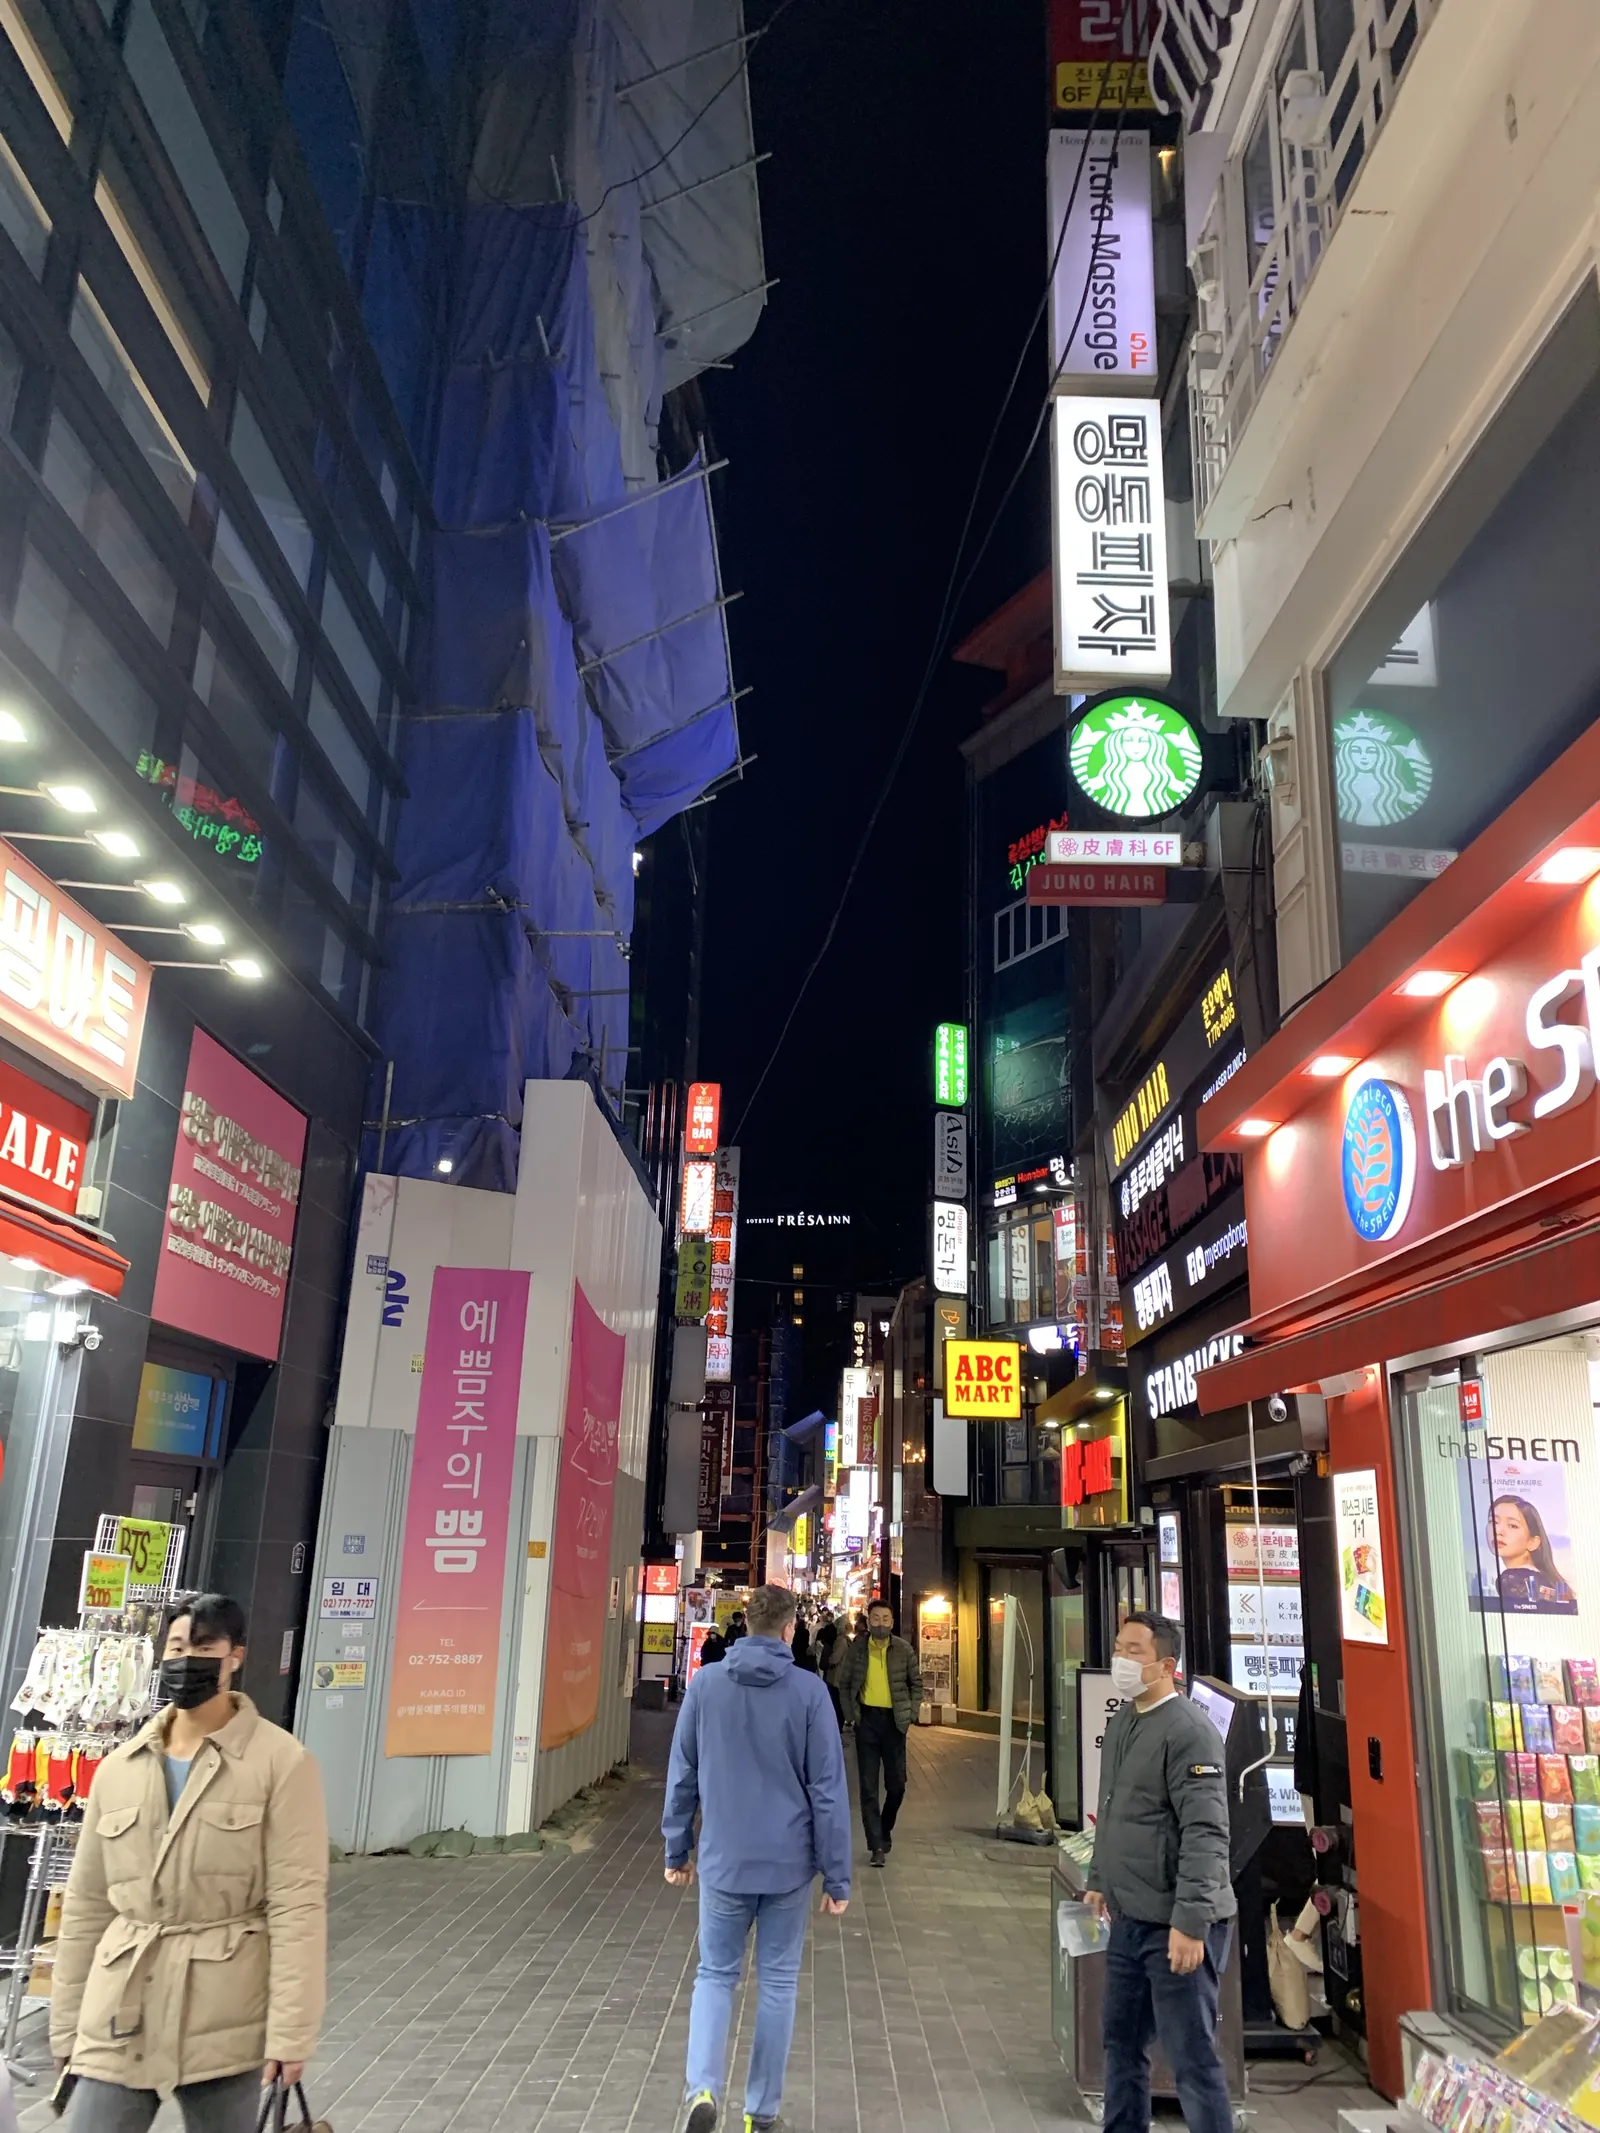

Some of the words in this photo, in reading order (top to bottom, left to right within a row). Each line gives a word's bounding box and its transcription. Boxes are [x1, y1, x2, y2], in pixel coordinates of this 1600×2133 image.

[1062, 85, 1092, 103] 6F
[1085, 232, 1121, 371] Massage
[1073, 414, 1157, 657] 명동피자
[1081, 838, 1148, 857] 皮膚科
[1153, 839, 1175, 856] 6F
[1041, 875, 1096, 891] JUNO
[1103, 875, 1156, 891] HAIR
[1202, 968, 1233, 1030] 준오헤어
[693, 1111, 714, 1124] PUB
[1112, 1102, 1140, 1167] JUNO
[1138, 1061, 1170, 1133] HAIR
[1424, 1054, 1525, 1171] the
[691, 1127, 713, 1139] BAR
[0, 1104, 78, 1191] ALE
[777, 1210, 825, 1226] FRÉSA
[828, 1215, 851, 1225] INN
[1369, 1190, 1396, 1234] SAEM
[937, 1209, 957, 1276] 명돈가
[1132, 1261, 1174, 1331] 명동피자
[955, 1354, 1012, 1382] ABC
[955, 1385, 1014, 1403] MART
[1438, 1434, 1478, 1460] the
[1487, 1436, 1580, 1463] SAEM
[1342, 1498, 1361, 1517] 마스크
[1361, 1497, 1375, 1516] 시트
[1352, 1518, 1365, 1539] 1+1
[120, 1526, 151, 1574] BTS
[439, 1638, 456, 1647] TEL
[408, 1653, 484, 1666] 02-752-8887
[420, 1689, 455, 1698] KAKAO
[456, 1688, 466, 1697] ID
